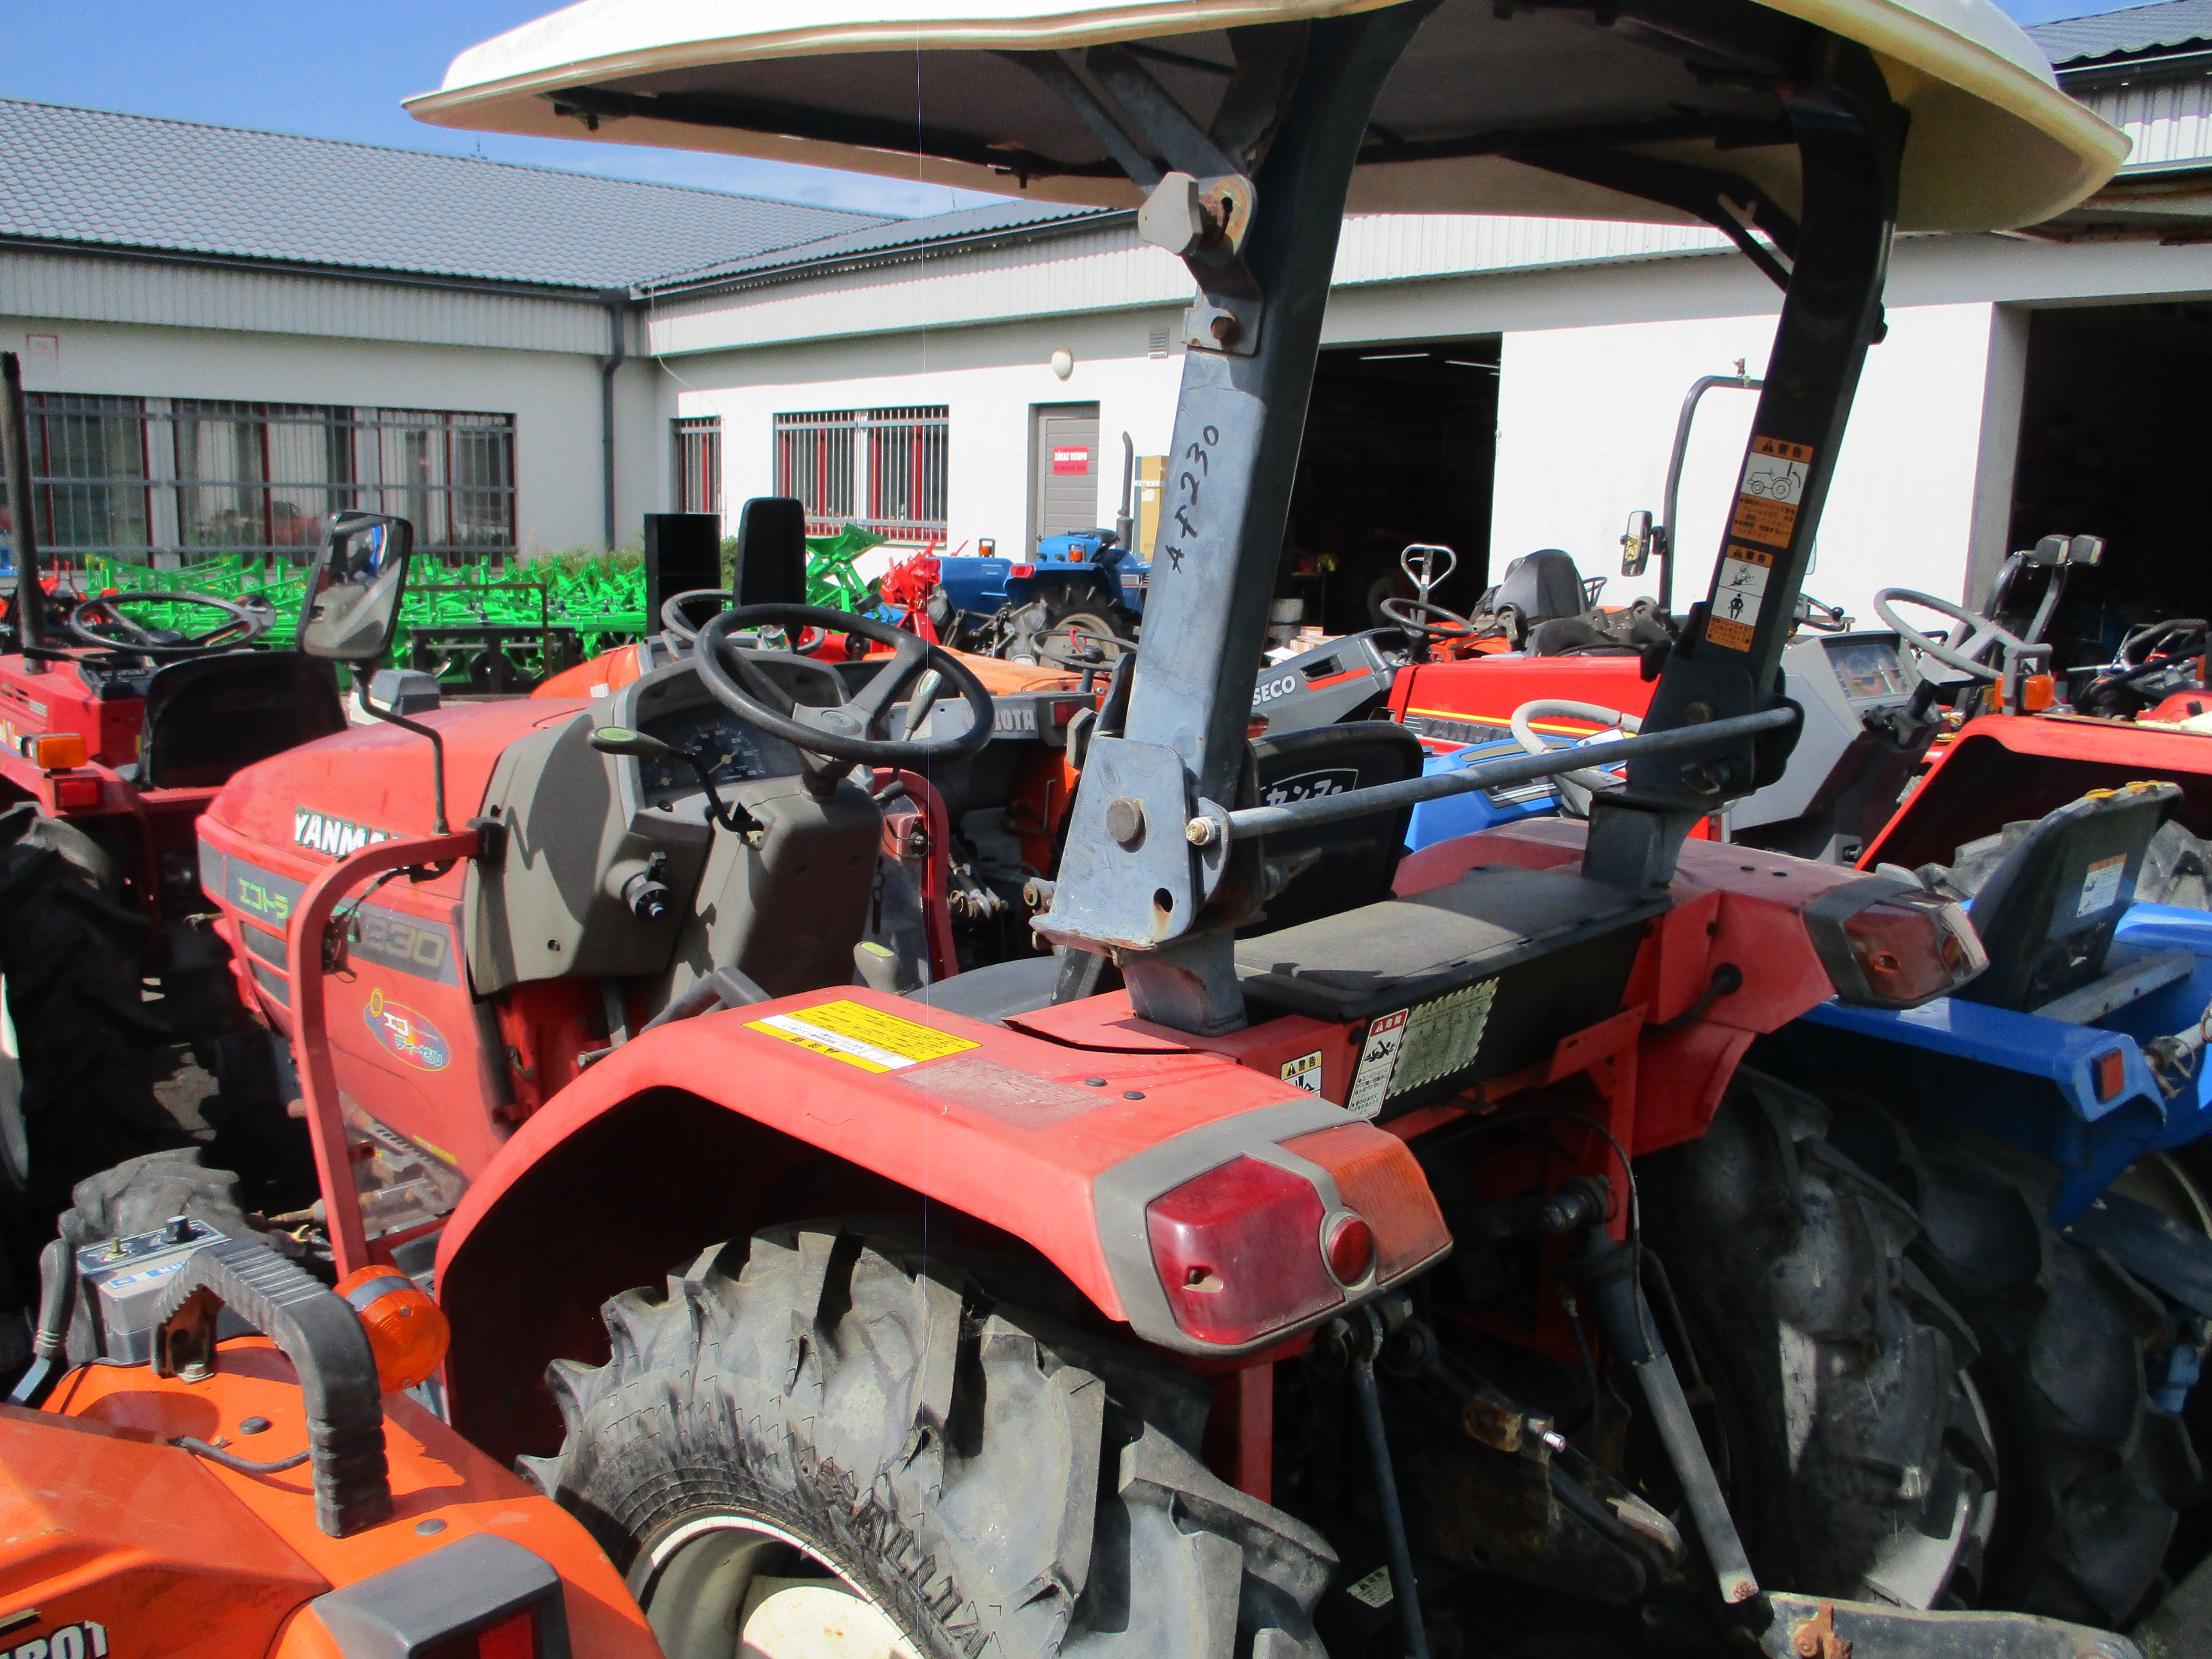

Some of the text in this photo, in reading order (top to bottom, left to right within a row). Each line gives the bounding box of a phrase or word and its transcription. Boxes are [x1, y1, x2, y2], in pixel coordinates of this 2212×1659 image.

[1054, 451, 1087, 461] ZÁKAZ VSTUPU
[1252, 675, 1296, 705] SECO
[238, 878, 290, 919] エコトラ
